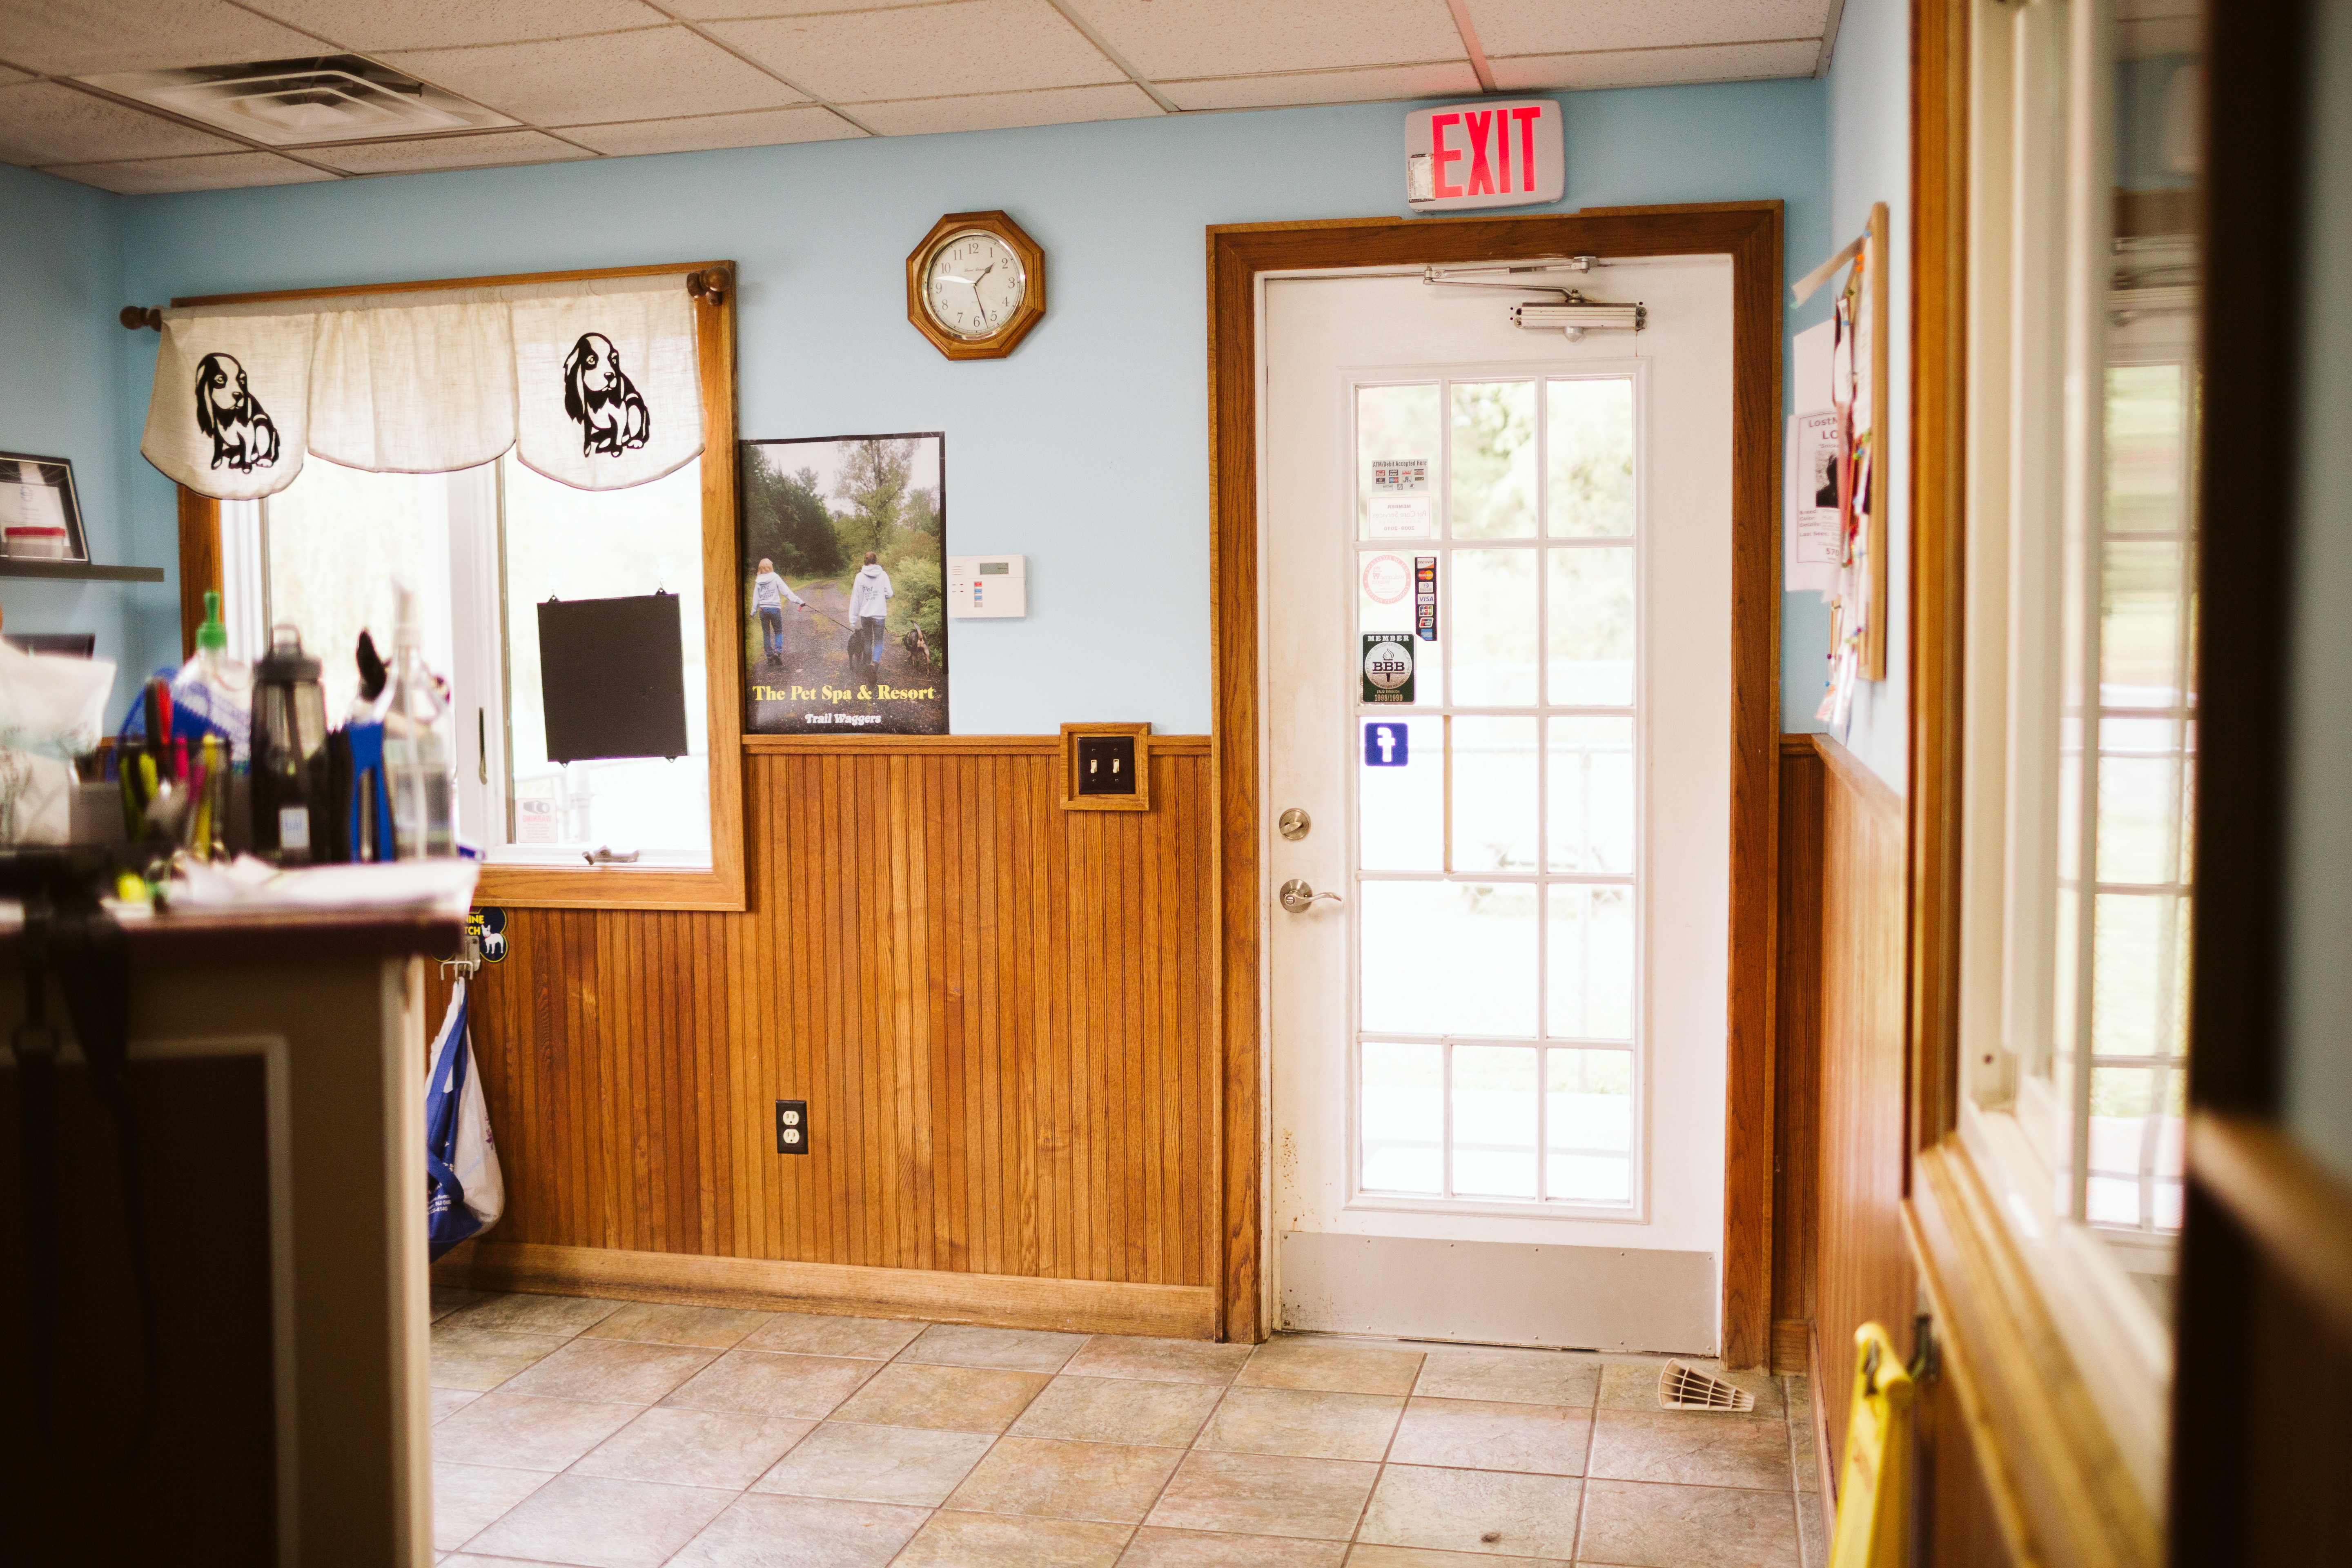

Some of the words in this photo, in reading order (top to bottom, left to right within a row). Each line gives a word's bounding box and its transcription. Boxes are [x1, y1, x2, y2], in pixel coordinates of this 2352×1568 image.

[1432, 106, 1541, 198] EXIT
[968, 243, 979, 254] 12
[989, 247, 993, 258] 1
[953, 249, 963, 261] 11
[941, 263, 951, 274] 10
[1002, 258, 1008, 269] 2
[935, 283, 942, 294] 9
[1008, 277, 1015, 289] 3
[942, 299, 949, 310] 8
[1002, 296, 1010, 307] 4
[957, 312, 963, 323] 7
[990, 310, 997, 321] 5
[973, 316, 980, 327] 6
[1374, 642, 1401, 650] BUSINESS
[1372, 662, 1405, 671] BBB
[752, 685, 786, 701] The
[791, 685, 816, 701] Pet
[822, 684, 852, 704] Spa
[857, 684, 872, 700] &
[877, 684, 935, 700] Resort
[1374, 694, 1403, 702] 1998/1999
[805, 713, 832, 724] Trail
[833, 713, 881, 726] Waggers
